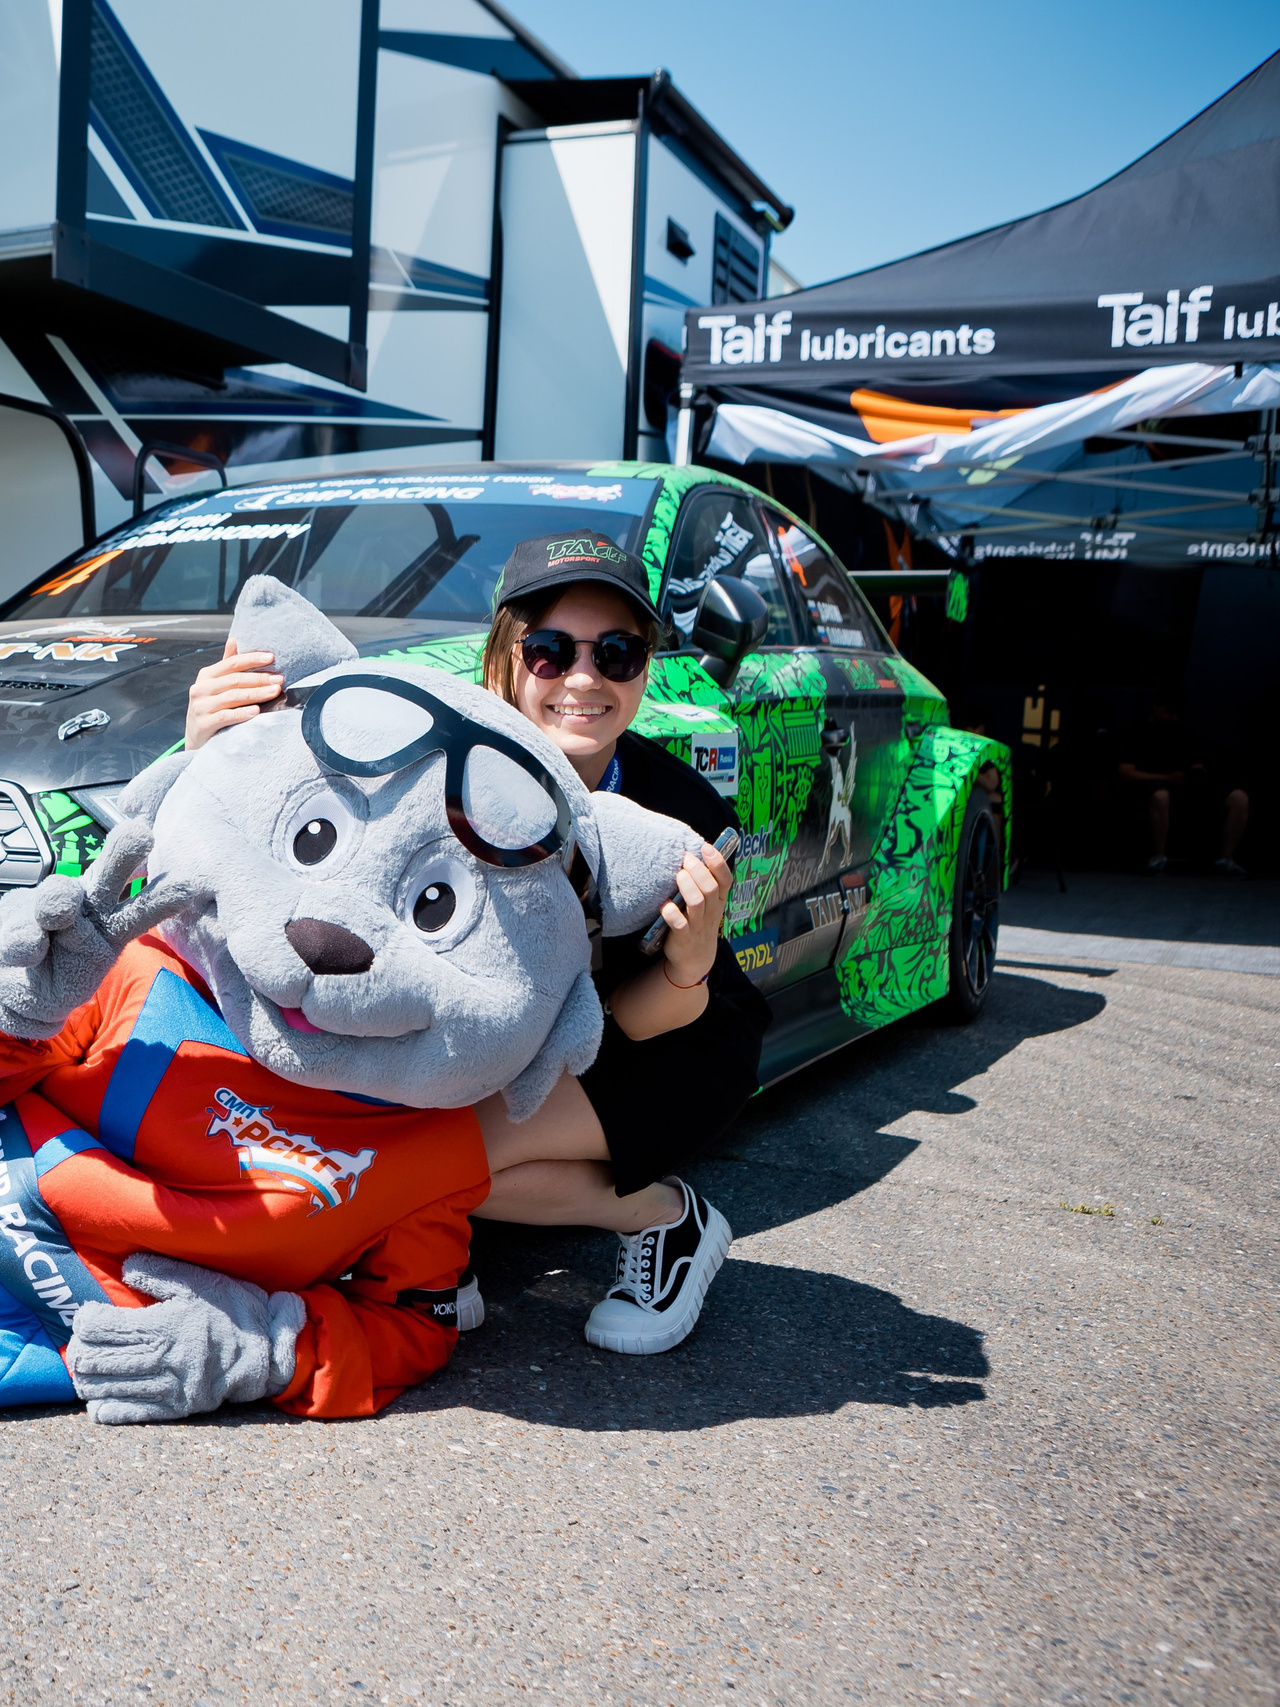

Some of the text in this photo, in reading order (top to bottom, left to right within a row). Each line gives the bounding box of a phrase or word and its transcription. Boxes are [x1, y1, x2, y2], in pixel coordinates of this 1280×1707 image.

[1098, 285, 1214, 349] Taif
[698, 310, 996, 365] Taif lubricants
[275, 486, 485, 505] SMP RACING
[547, 555, 601, 568] MOTORSPORT
[694, 746, 718, 772] TCR
[215, 1089, 256, 1119] СМП
[235, 1120, 343, 1173] РСКГ
[433, 1301, 457, 1315] YOKO
